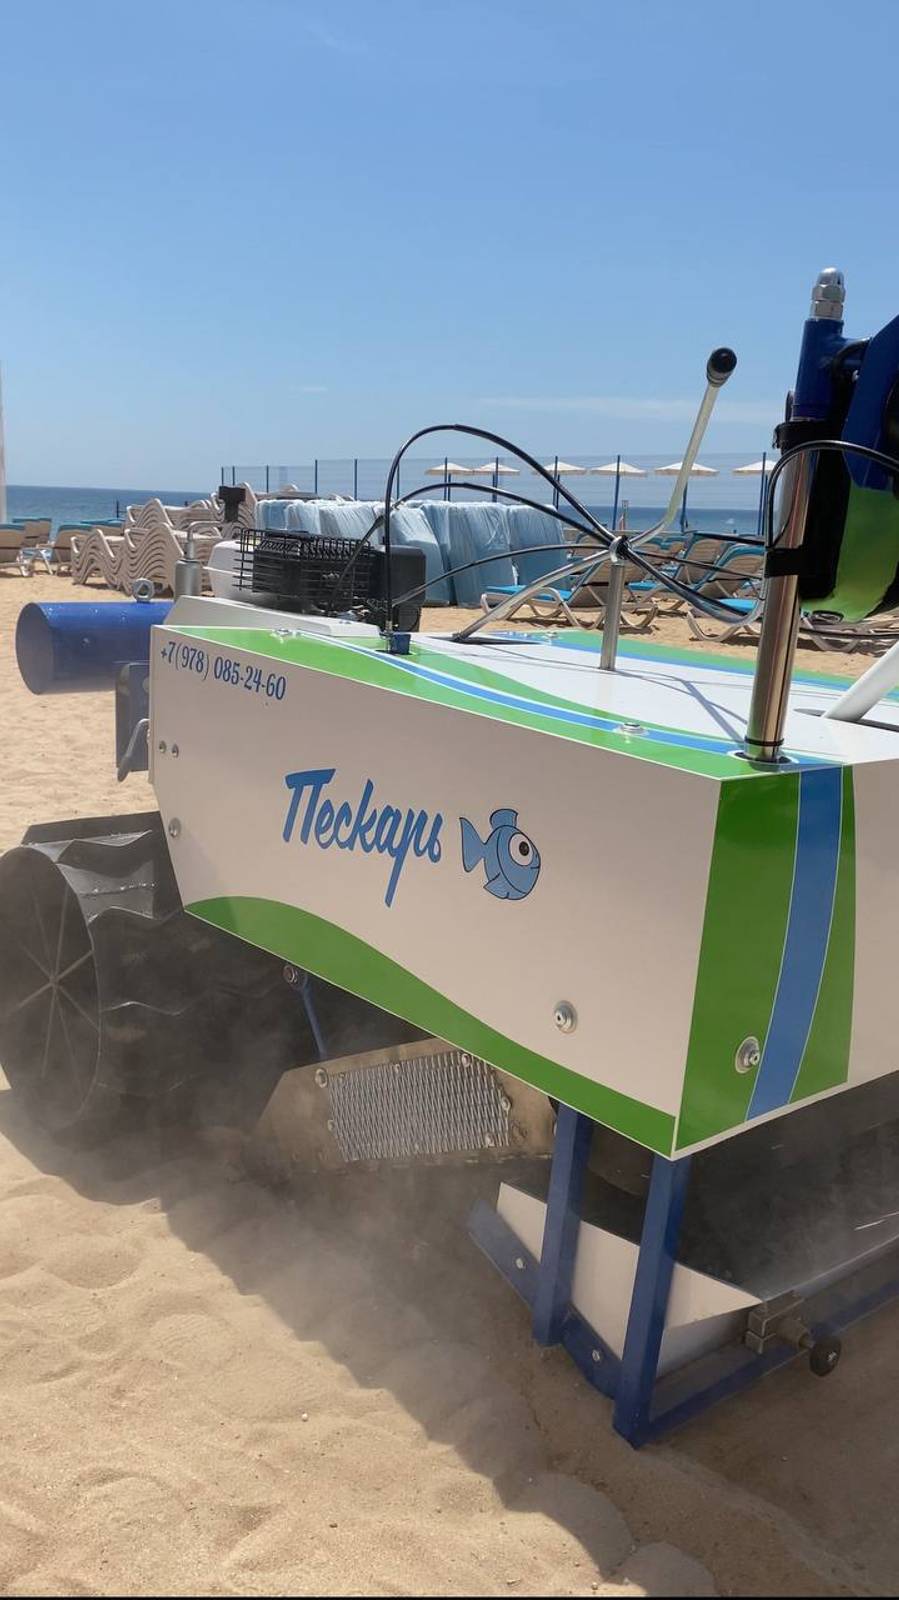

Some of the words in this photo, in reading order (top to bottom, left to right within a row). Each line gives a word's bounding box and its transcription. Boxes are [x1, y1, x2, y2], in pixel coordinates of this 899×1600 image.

[161, 641, 210, 682] +7(978)
[214, 656, 287, 700] 085-24-60
[282, 768, 443, 908] Пескарь
